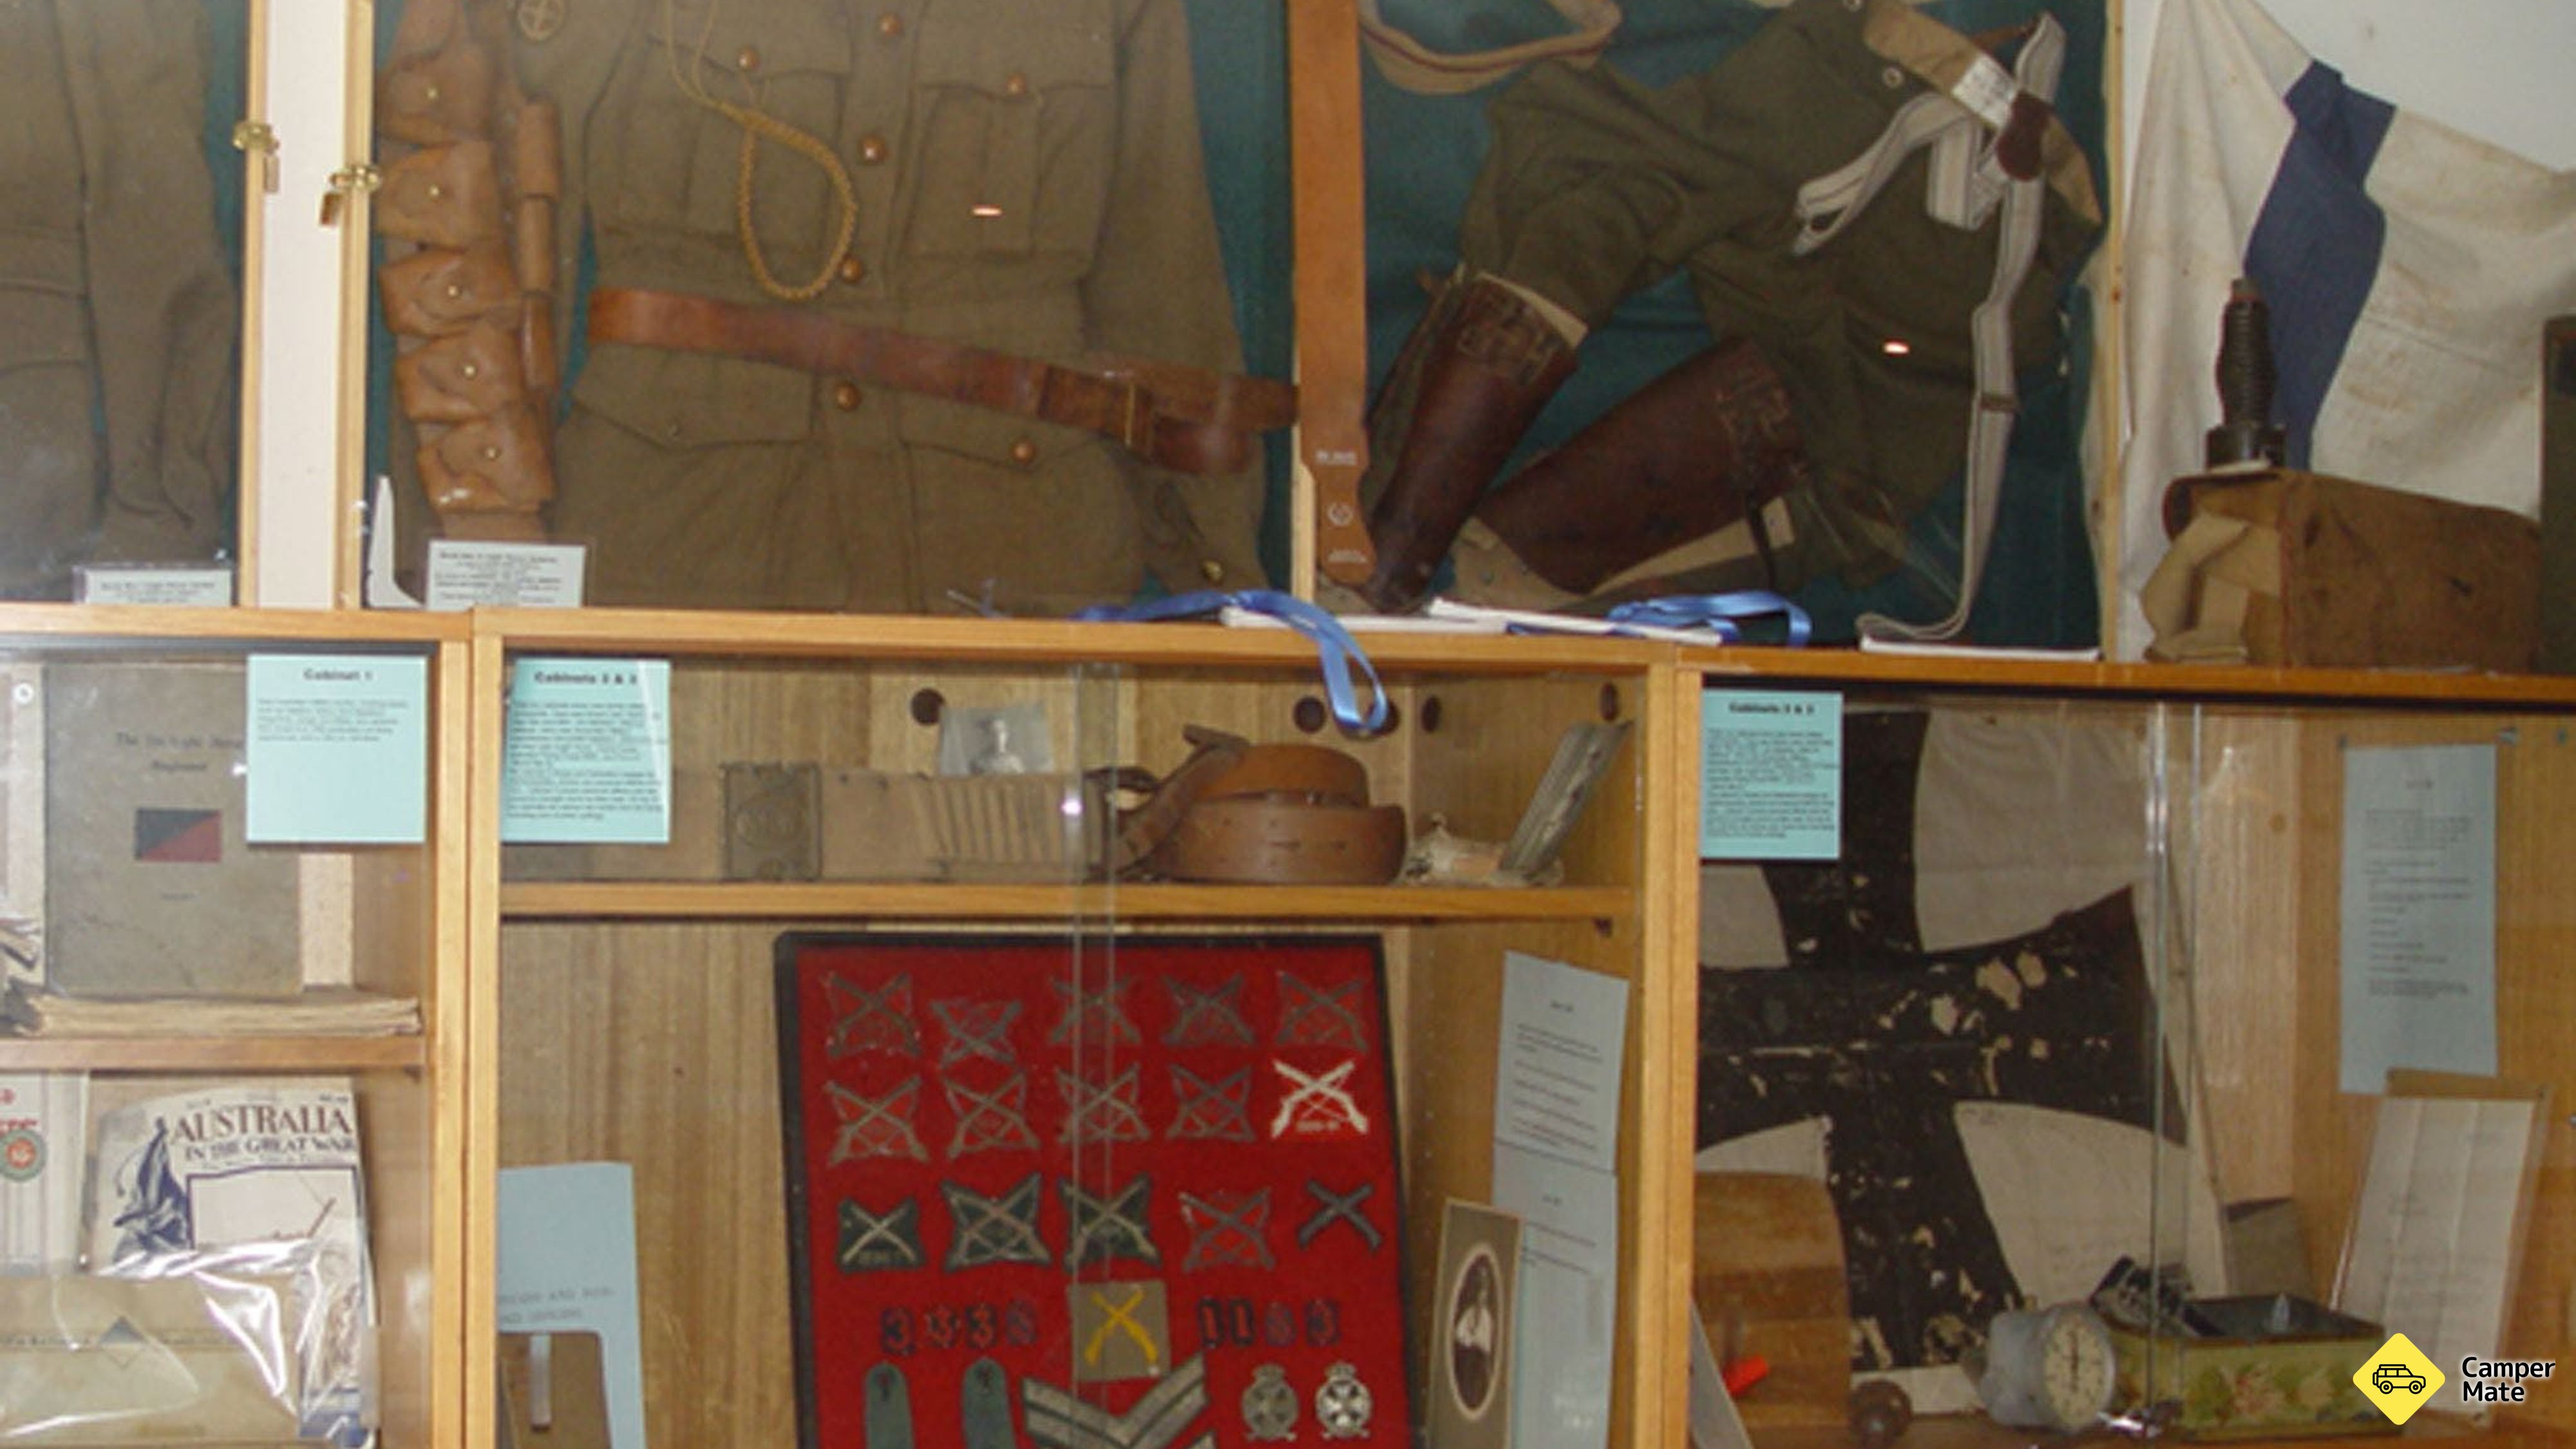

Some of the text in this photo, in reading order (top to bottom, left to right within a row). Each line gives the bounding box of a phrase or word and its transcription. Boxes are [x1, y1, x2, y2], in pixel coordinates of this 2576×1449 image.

[303, 668, 360, 681] Cabinet
[170, 1104, 353, 1145] AUSTRALIA
[185, 1146, 205, 1160] IN
[245, 1137, 308, 1154] GREAT
[311, 1136, 355, 1151] WAR
